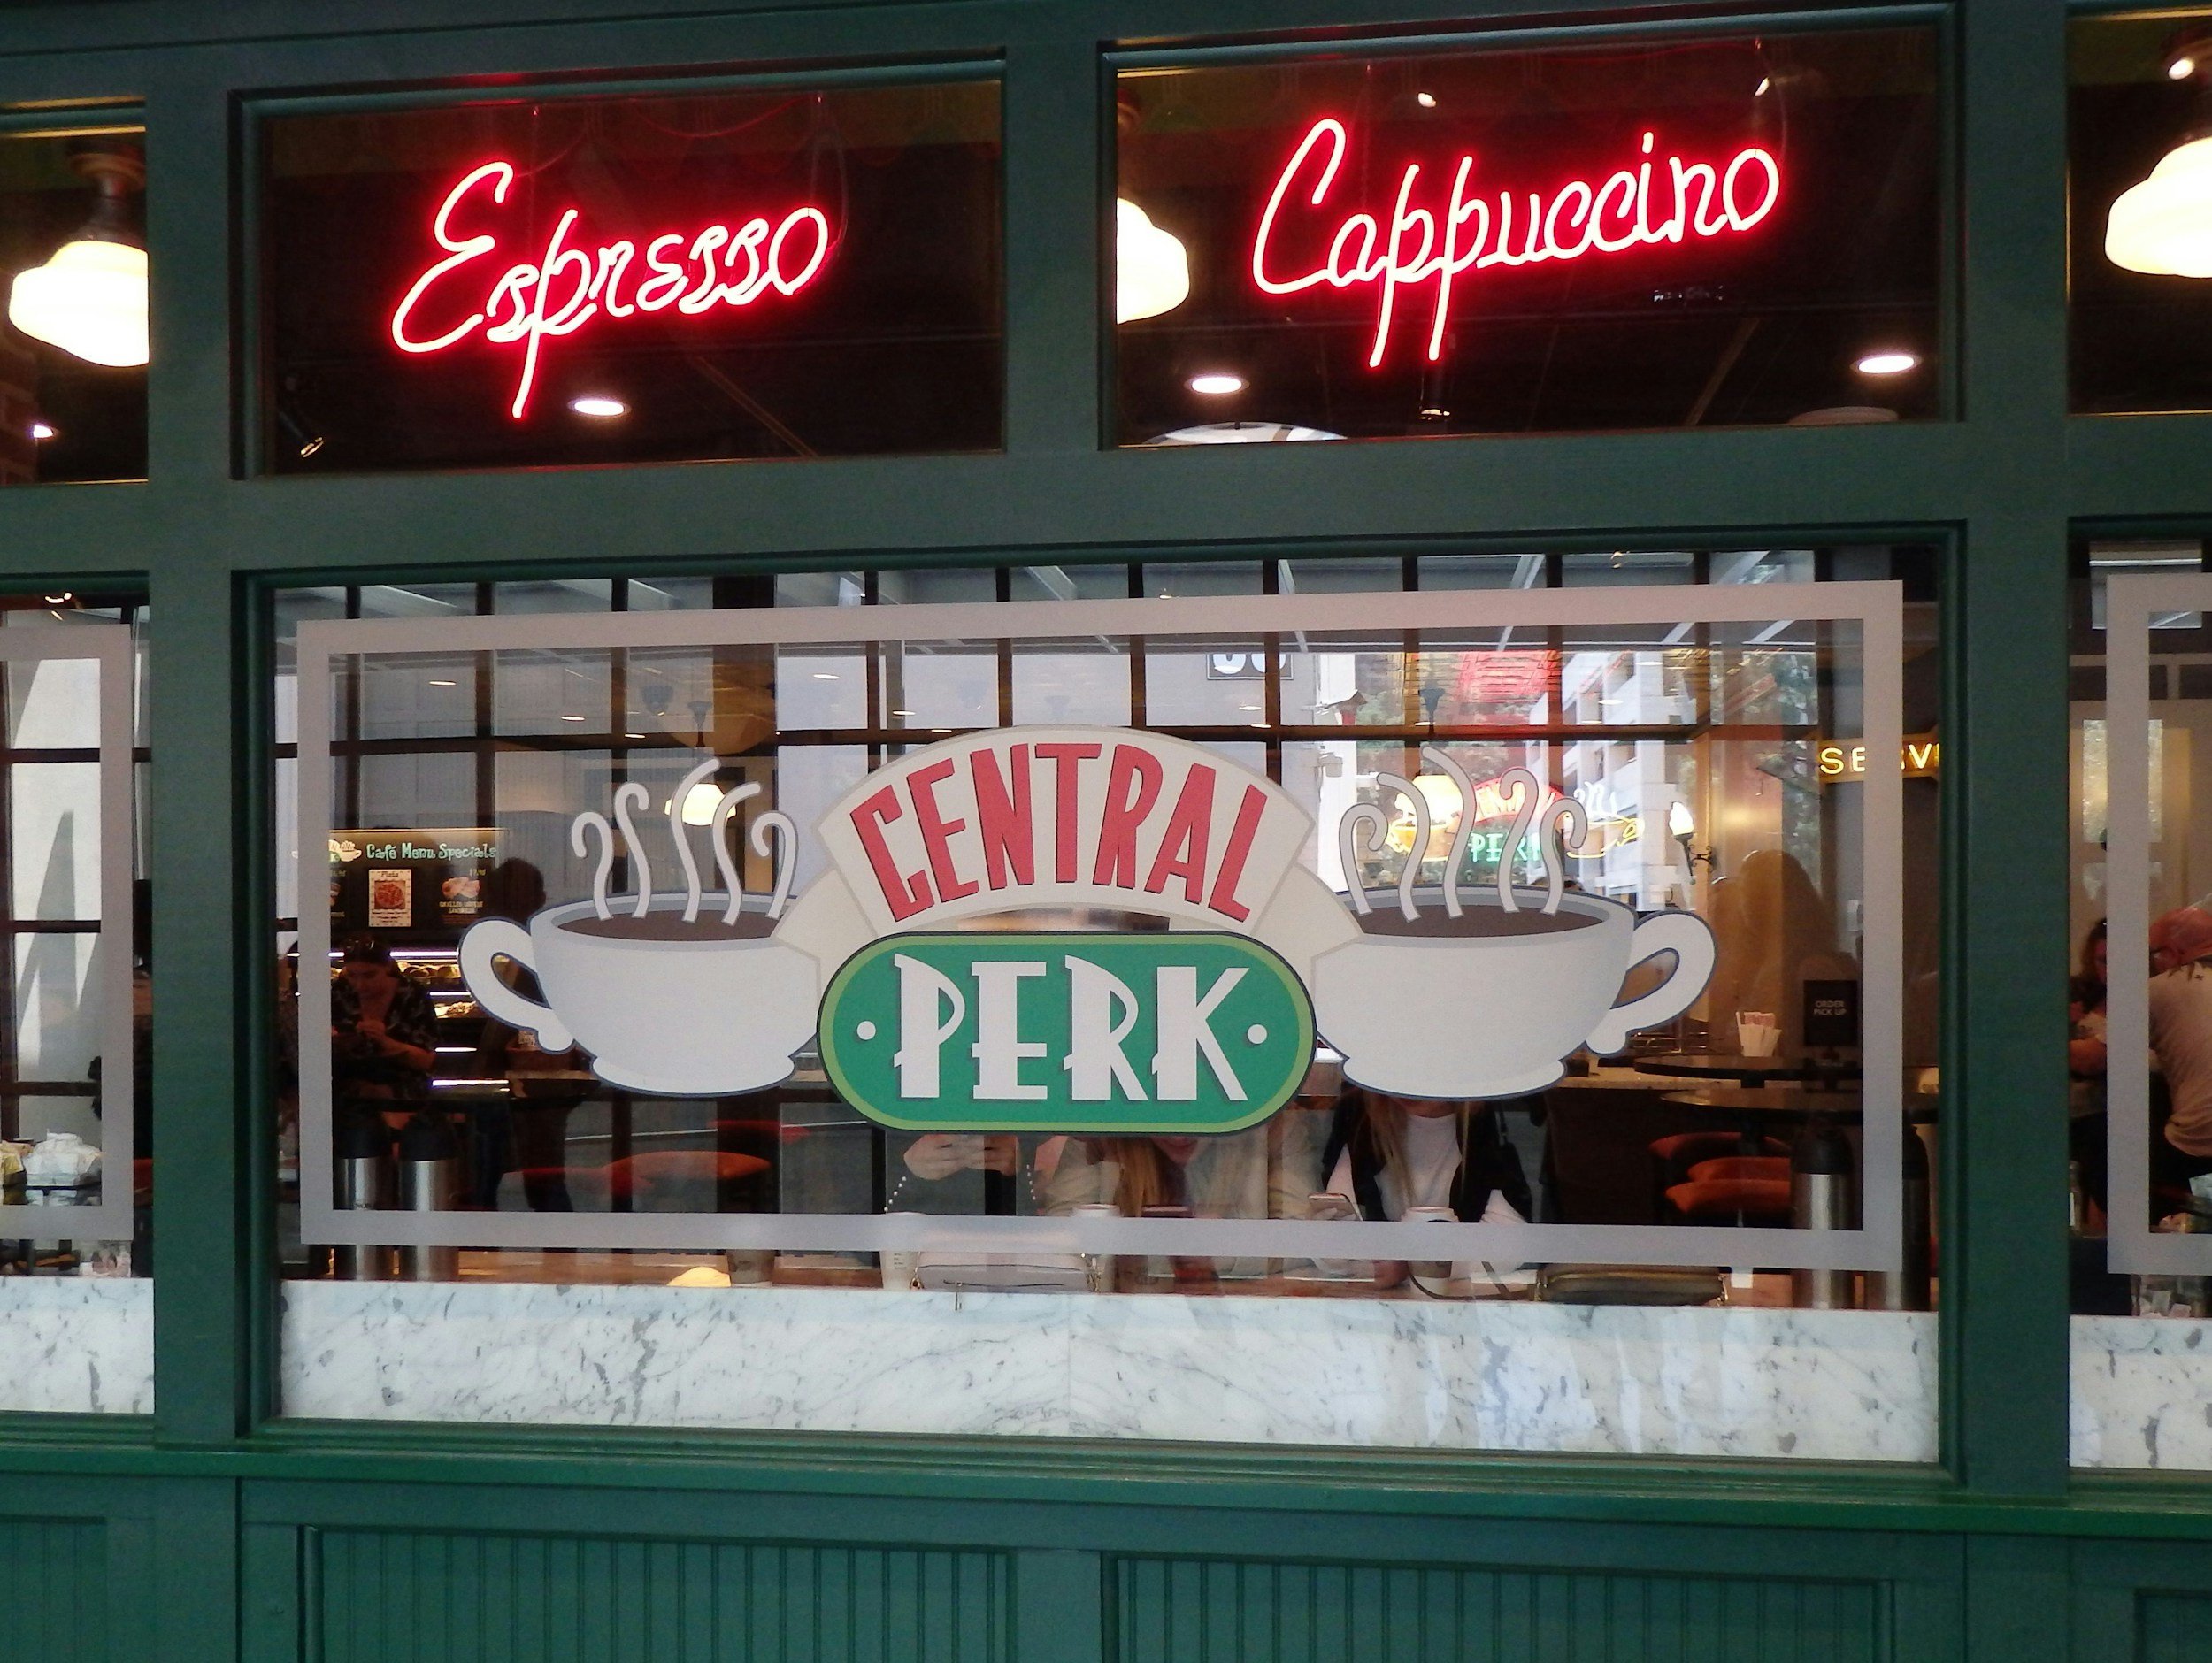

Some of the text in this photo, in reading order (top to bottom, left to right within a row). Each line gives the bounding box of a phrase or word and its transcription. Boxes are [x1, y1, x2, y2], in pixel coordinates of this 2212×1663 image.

[392, 161, 829, 419] Espresso
[1253, 118, 1780, 367] Cappuccino
[849, 742, 1269, 923] CENTRAL
[1820, 742, 1940, 775] SEV
[366, 842, 497, 862] Café Menu Specials
[894, 953, 1250, 1102] PERK
